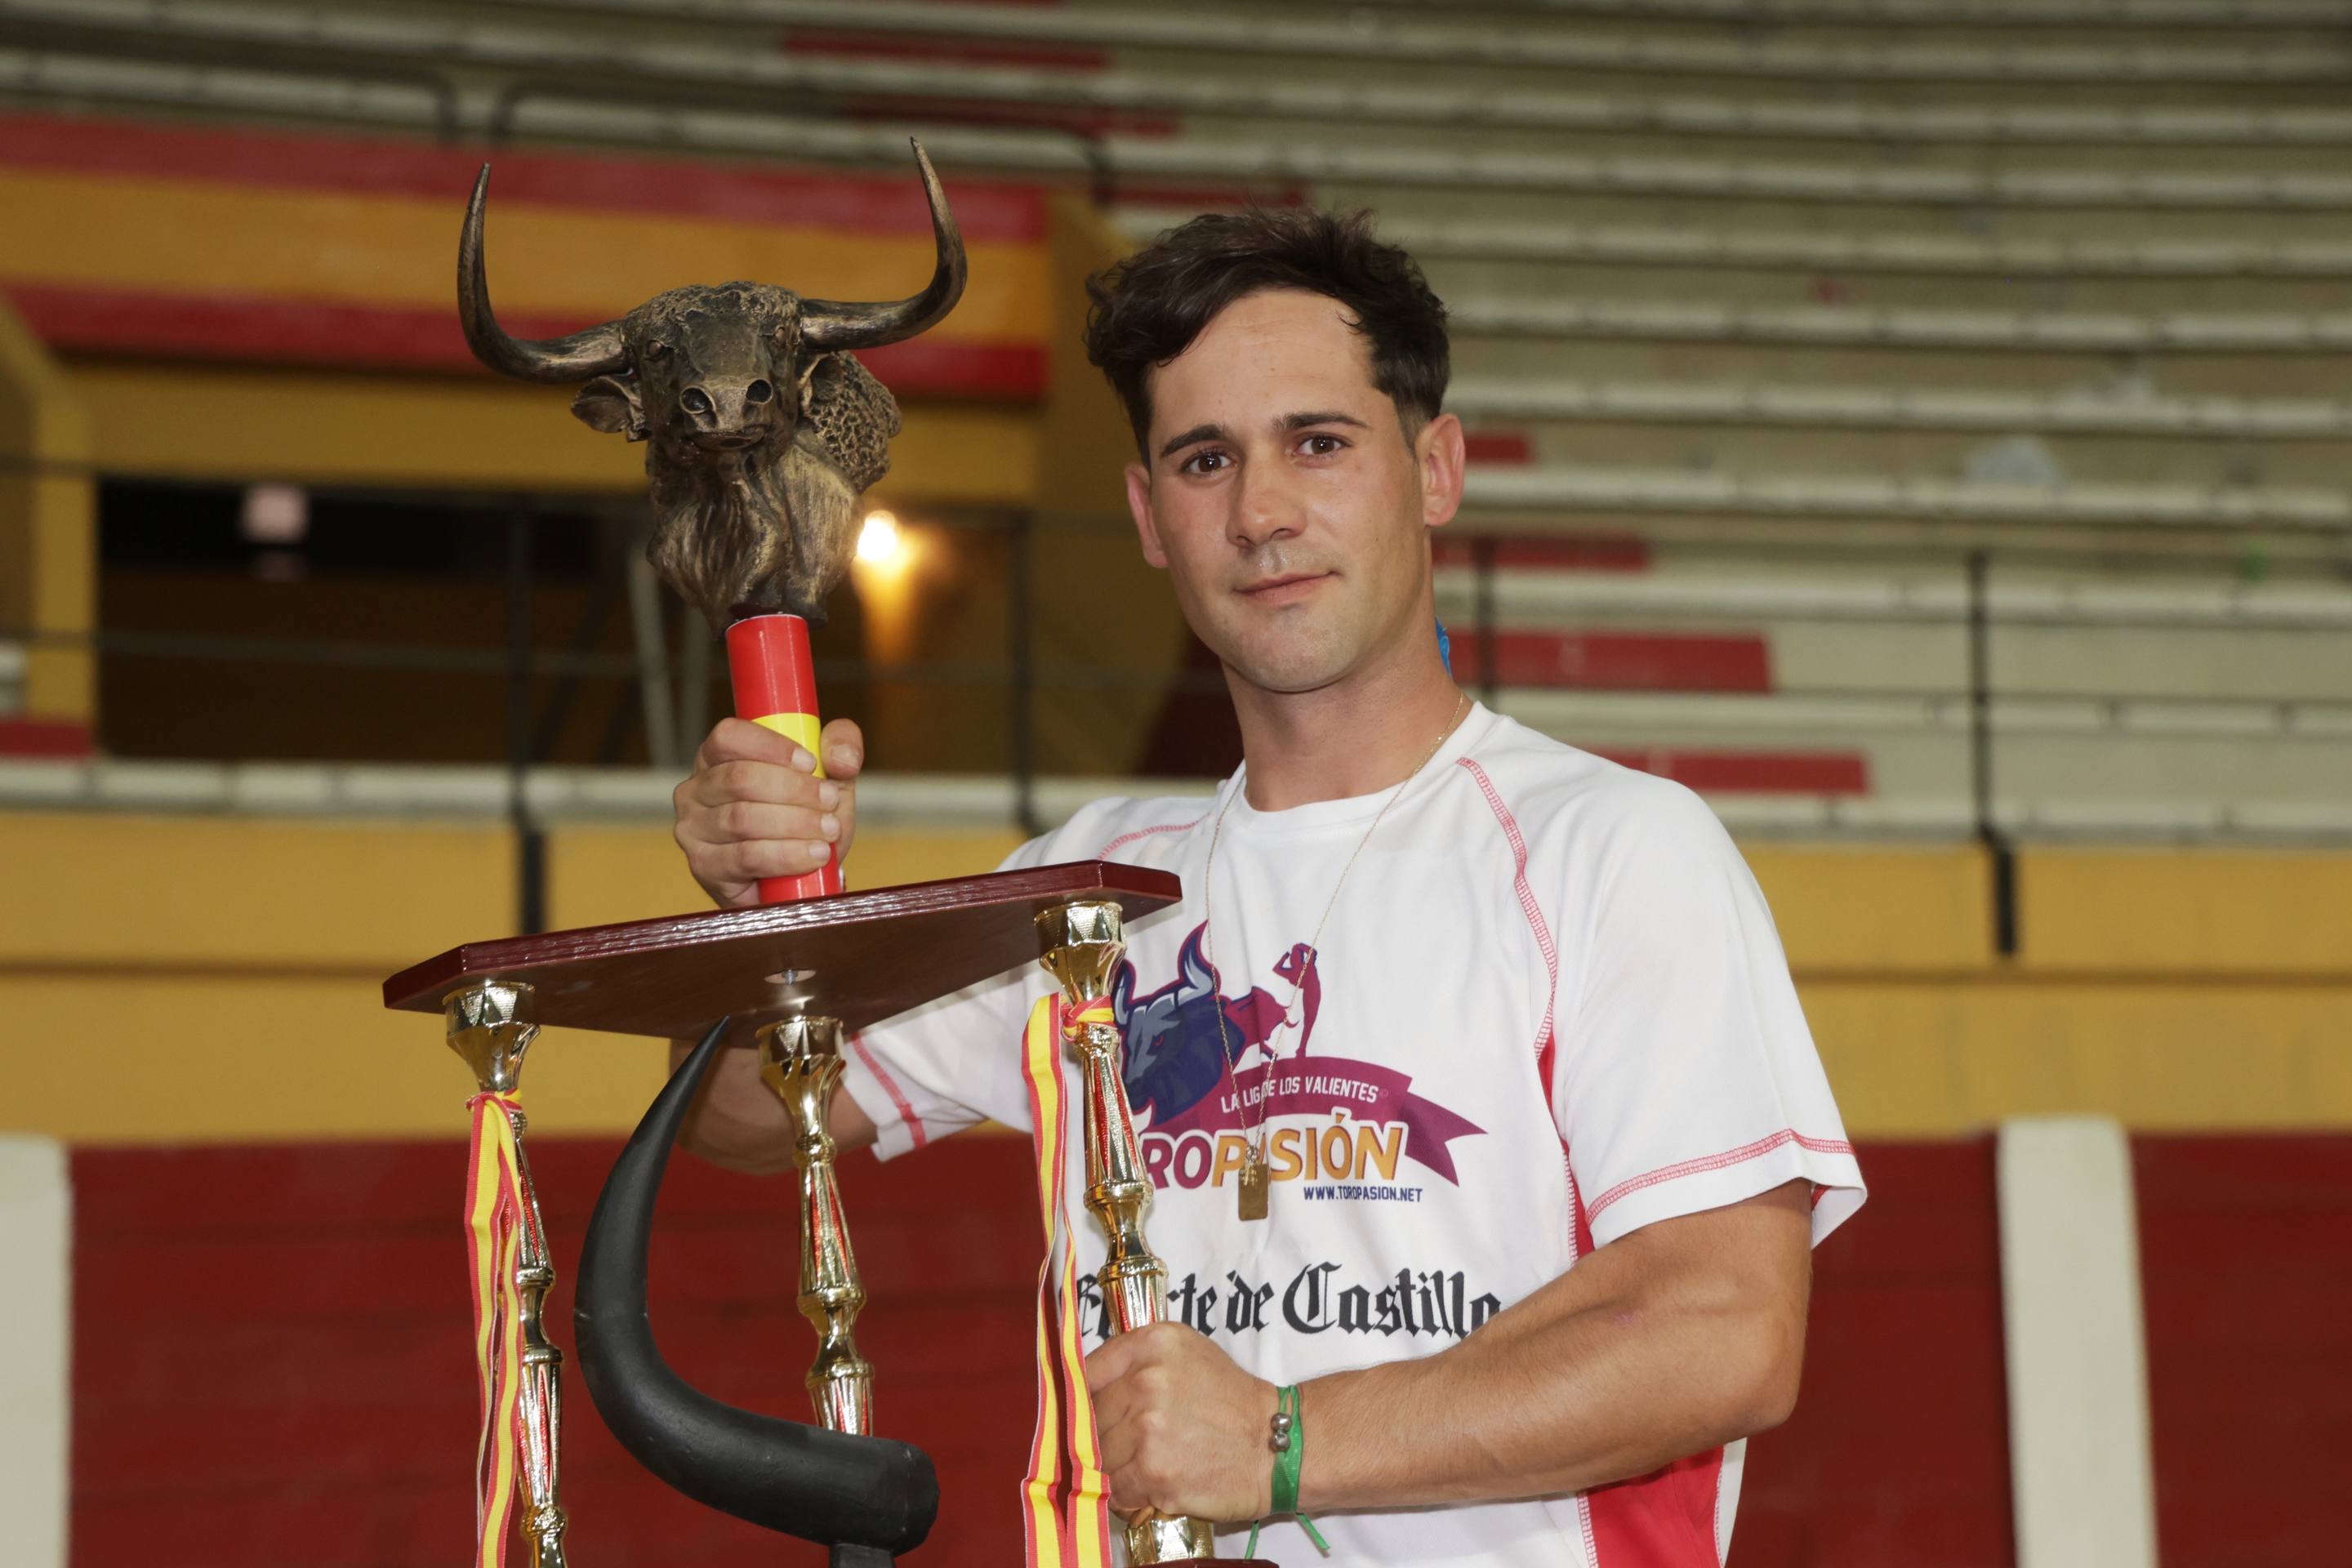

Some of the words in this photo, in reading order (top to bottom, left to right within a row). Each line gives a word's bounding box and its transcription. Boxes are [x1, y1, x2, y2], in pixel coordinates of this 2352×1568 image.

[1221, 1092, 1241, 1113] LA
[1279, 1076, 1300, 1096] LOS
[1305, 1076, 1379, 1103] VALIENTES
[1303, 1185, 1423, 1203] WWW.TOROPASION.NET
[1225, 1270, 1275, 1335] de
